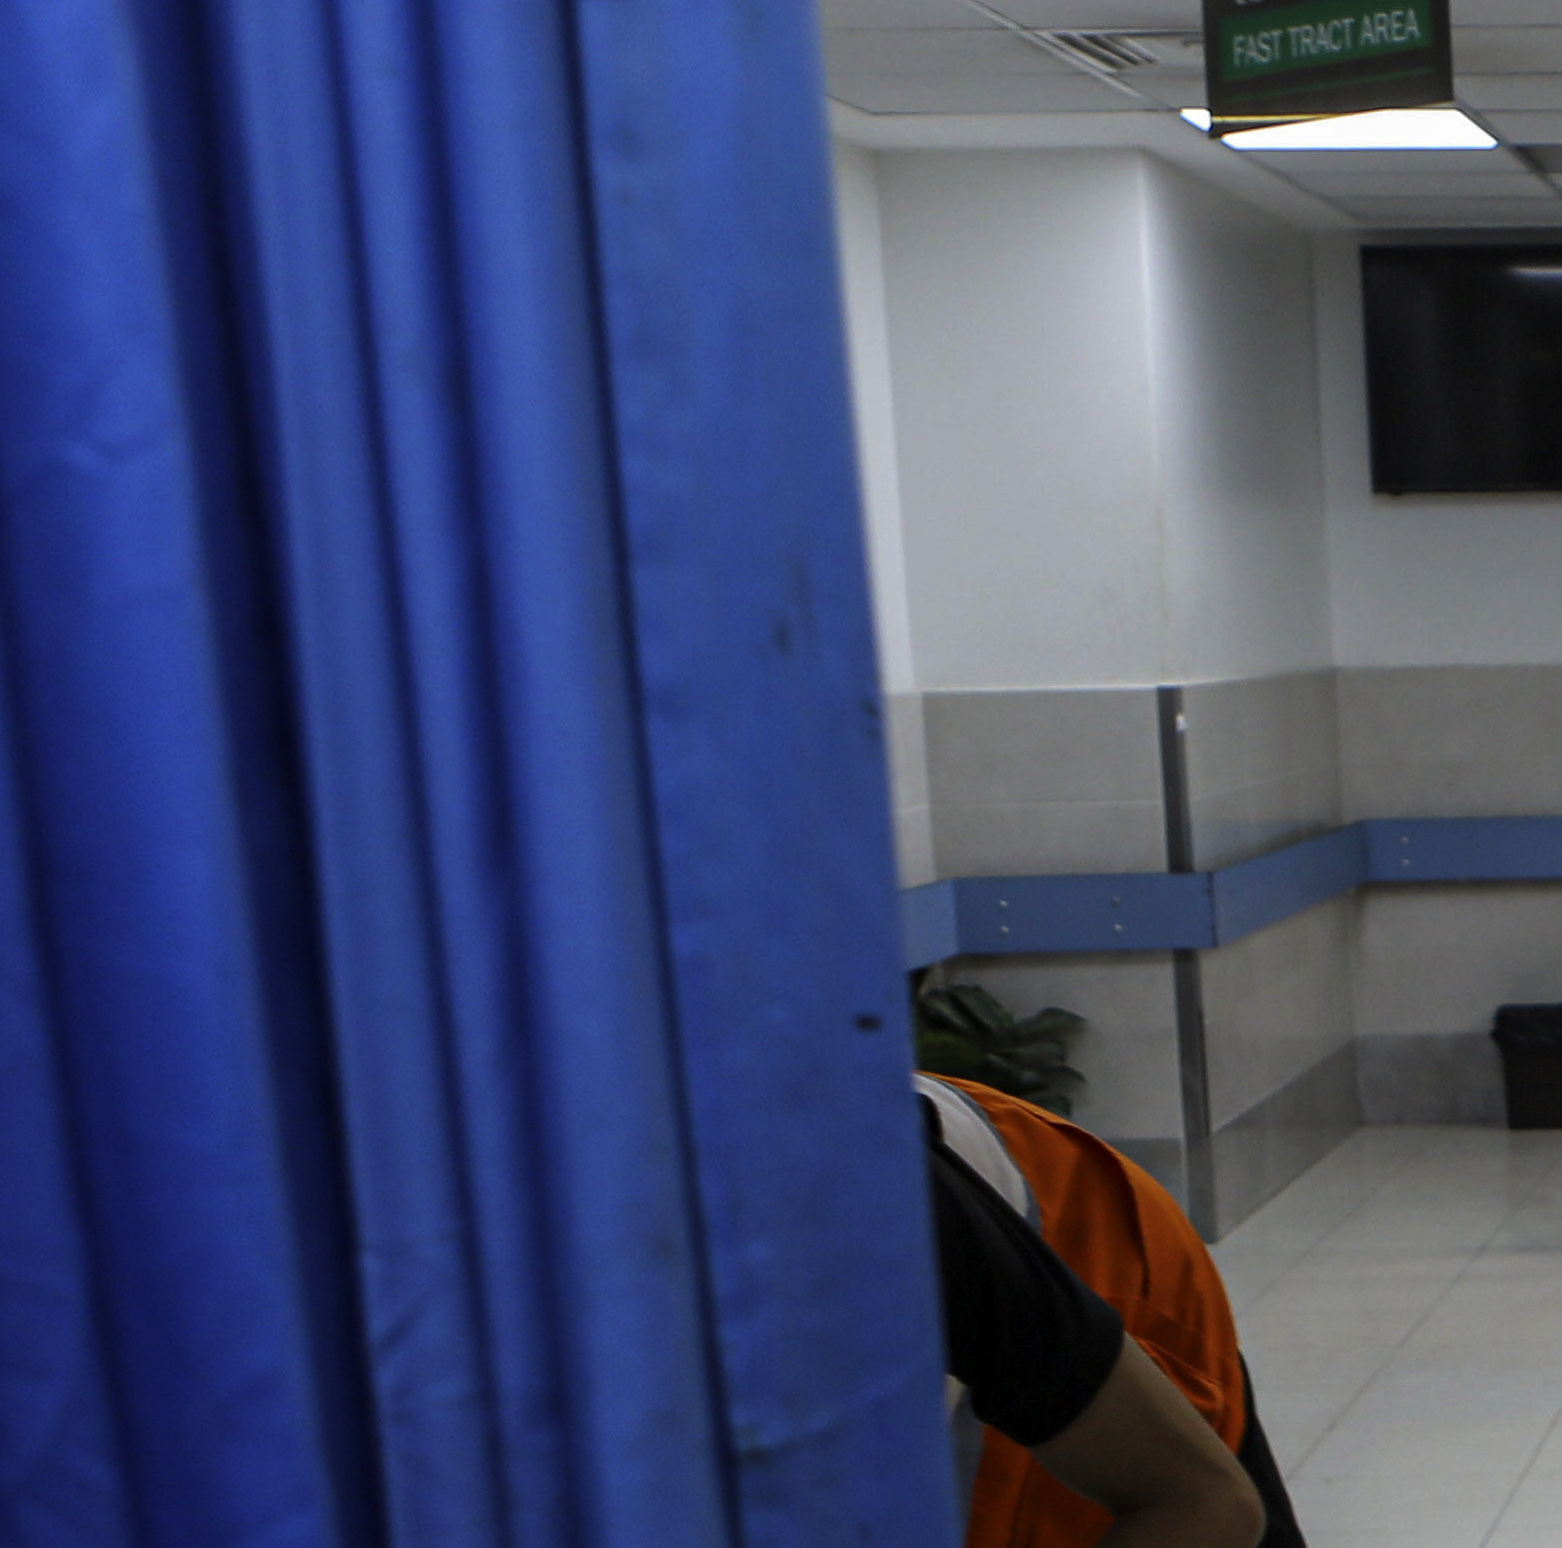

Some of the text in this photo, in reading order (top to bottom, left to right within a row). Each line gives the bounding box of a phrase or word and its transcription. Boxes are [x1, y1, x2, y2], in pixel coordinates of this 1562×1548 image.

[1233, 8, 1421, 66] FAST TRACT AREA
